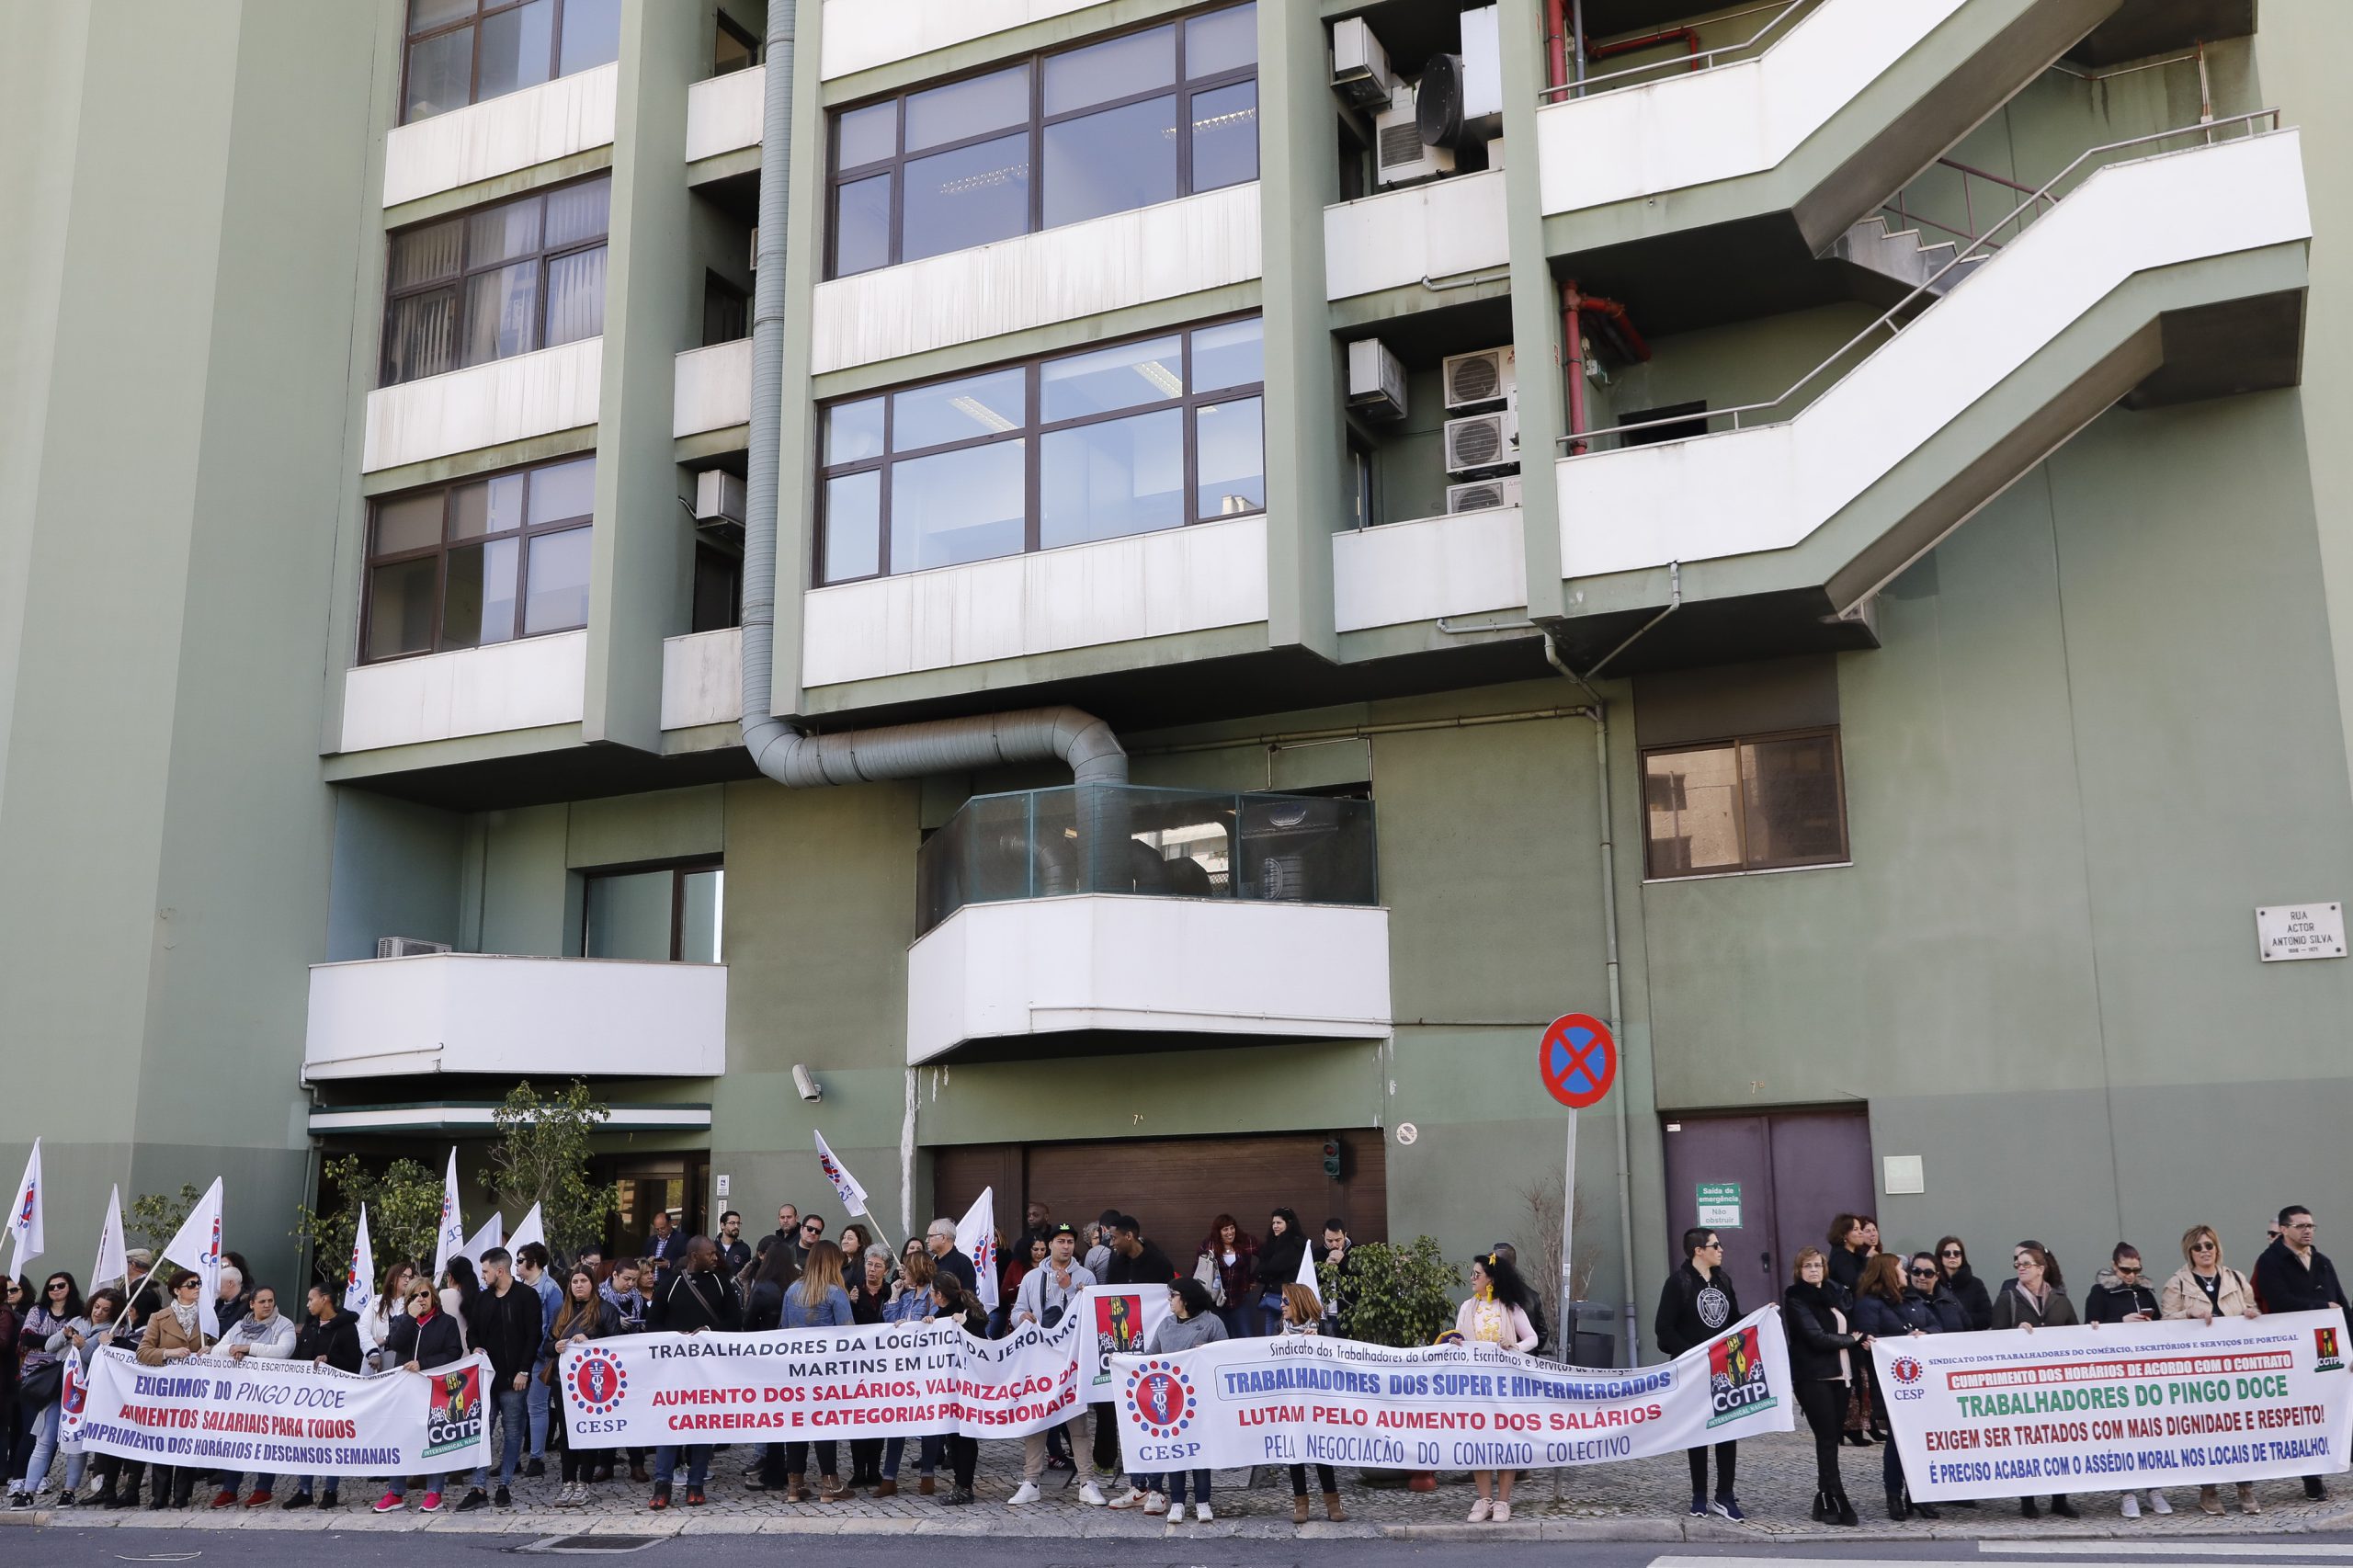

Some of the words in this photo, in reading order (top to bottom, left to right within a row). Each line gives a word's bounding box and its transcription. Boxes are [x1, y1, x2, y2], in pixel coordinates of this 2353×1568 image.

[2287, 923, 2314, 933] ACTOR
[2290, 911, 2308, 920] RUA
[2310, 935, 2333, 944] SILVA
[1699, 1196, 1739, 1204] emergência
[1702, 1187, 1722, 1195] Saída
[649, 1339, 827, 1359] TRABALHADORES
[835, 1337, 867, 1353] DA
[875, 1330, 962, 1350] LOGÍSTICA
[966, 1341, 990, 1362] DA
[1269, 1339, 1313, 1357] Sindicato
[1316, 1342, 1333, 1358] dos
[1336, 1345, 1403, 1363] Trabalhadores
[1406, 1351, 1418, 1363] do
[1422, 1349, 1470, 1364] Comércio,
[1473, 1348, 1521, 1366] Escritórios
[1525, 1359, 1531, 1368] e
[1928, 1356, 1975, 1366] SINDICATO
[1976, 1354, 1994, 1362] DOS
[1995, 1350, 2070, 1360] TRABALHADORES
[2086, 1344, 2133, 1355] COMÉRCIO,
[2134, 1341, 2191, 1352] ESCRITÓRIOS
[2200, 1338, 2242, 1348] SERVIÇOS
[2244, 1337, 2255, 1346] DE
[2256, 1334, 2298, 1344] PORTUGAL
[261, 1361, 305, 1374] ESCRITÓRIOS
[306, 1366, 312, 1374] E
[789, 1358, 888, 1378] MARTINS
[894, 1357, 921, 1372] EM
[927, 1353, 967, 1370] LUTA!
[1951, 1369, 2037, 1389] CUMPRIMENTO
[2039, 1368, 2063, 1382] DOS
[2064, 1363, 2124, 1380] HORÁRIOS
[2127, 1363, 2143, 1377] DE
[2143, 1359, 2192, 1375] ACORDO
[2193, 1358, 2221, 1373] COM
[2222, 1358, 2233, 1371] O
[2234, 1354, 2291, 1370] CONTRATO
[134, 1375, 210, 1399] EXIGIMOS
[214, 1381, 232, 1401] DO
[235, 1382, 290, 1405] PINGO
[294, 1386, 346, 1409] DOCE
[652, 1388, 757, 1407] AUMENTO
[764, 1386, 805, 1403] DOS
[813, 1379, 921, 1401] SALÁRIOS,
[1059, 1359, 1078, 1386] DA
[1224, 1367, 1381, 1395] TRABALHADORES
[1390, 1374, 1428, 1396] DOS
[1433, 1374, 1493, 1396] SUPER
[1497, 1376, 1507, 1397] E
[1512, 1371, 1671, 1400] HIPERMERCADOS
[1712, 1381, 1767, 1412] CGTP
[1893, 1389, 1925, 1400] CESP
[1956, 1384, 2129, 1418] TRABALHADORES
[2134, 1384, 2163, 1407] DO
[2168, 1380, 2230, 1405] PINGO
[2236, 1375, 2289, 1400] DOCE
[202, 1410, 268, 1434] SALARIAIS
[272, 1416, 303, 1437] PARA
[308, 1418, 356, 1439] TODOS
[428, 1418, 482, 1444] CGTP
[575, 1419, 628, 1434] CESP
[668, 1412, 785, 1431] CARREIRAS
[791, 1412, 804, 1427] E
[811, 1404, 935, 1426] CATEGORIAS
[1238, 1405, 1305, 1426] LUTAM
[1313, 1405, 1369, 1426] PELO
[1375, 1410, 1486, 1430] AUMENTO
[1494, 1413, 1542, 1431] DOS
[1549, 1403, 1662, 1431] SALÁRIOS
[1926, 1428, 1980, 1451] EXIGEM
[1984, 1426, 2011, 1448] SER
[2015, 1422, 2088, 1446] TRATADOS
[2092, 1419, 2123, 1440] COM
[2127, 1417, 2163, 1438] MAIS
[2166, 1411, 2241, 1437] DIGNIDADE
[2245, 1411, 2253, 1430] E
[2257, 1404, 2325, 1428] RESPEITO!
[168, 1437, 193, 1455] DOS
[194, 1437, 252, 1460] HORÁRIOS
[255, 1443, 262, 1460] E
[263, 1444, 332, 1464] DESCANSOS
[335, 1447, 401, 1465] SEMANAIS
[424, 1441, 463, 1457] INTERSINDICAL
[464, 1436, 481, 1446] NACIO
[1139, 1442, 1201, 1461] CESP
[1264, 1434, 1296, 1460] PELA
[1306, 1433, 1404, 1463] NEGOCIAÇÃO
[1418, 1441, 1439, 1465] DO
[1453, 1441, 1533, 1465] CONTRATO
[1547, 1436, 1631, 1463] COLECTIVO
[1930, 1460, 1938, 1484] É
[1940, 1461, 1991, 1483] PRECISO
[1995, 1458, 2040, 1480] ACABAR
[2044, 1457, 2069, 1477] COM
[2073, 1456, 2081, 1474] O
[2085, 1449, 2134, 1473] ASSÉDIO
[2137, 1450, 2178, 1471] MORAL
[2181, 1448, 2205, 1467] NOS
[2207, 1444, 2250, 1466] LOCAIS
[2252, 1443, 2266, 1462] DE
[2268, 1437, 2330, 1460] TRABALHO!
